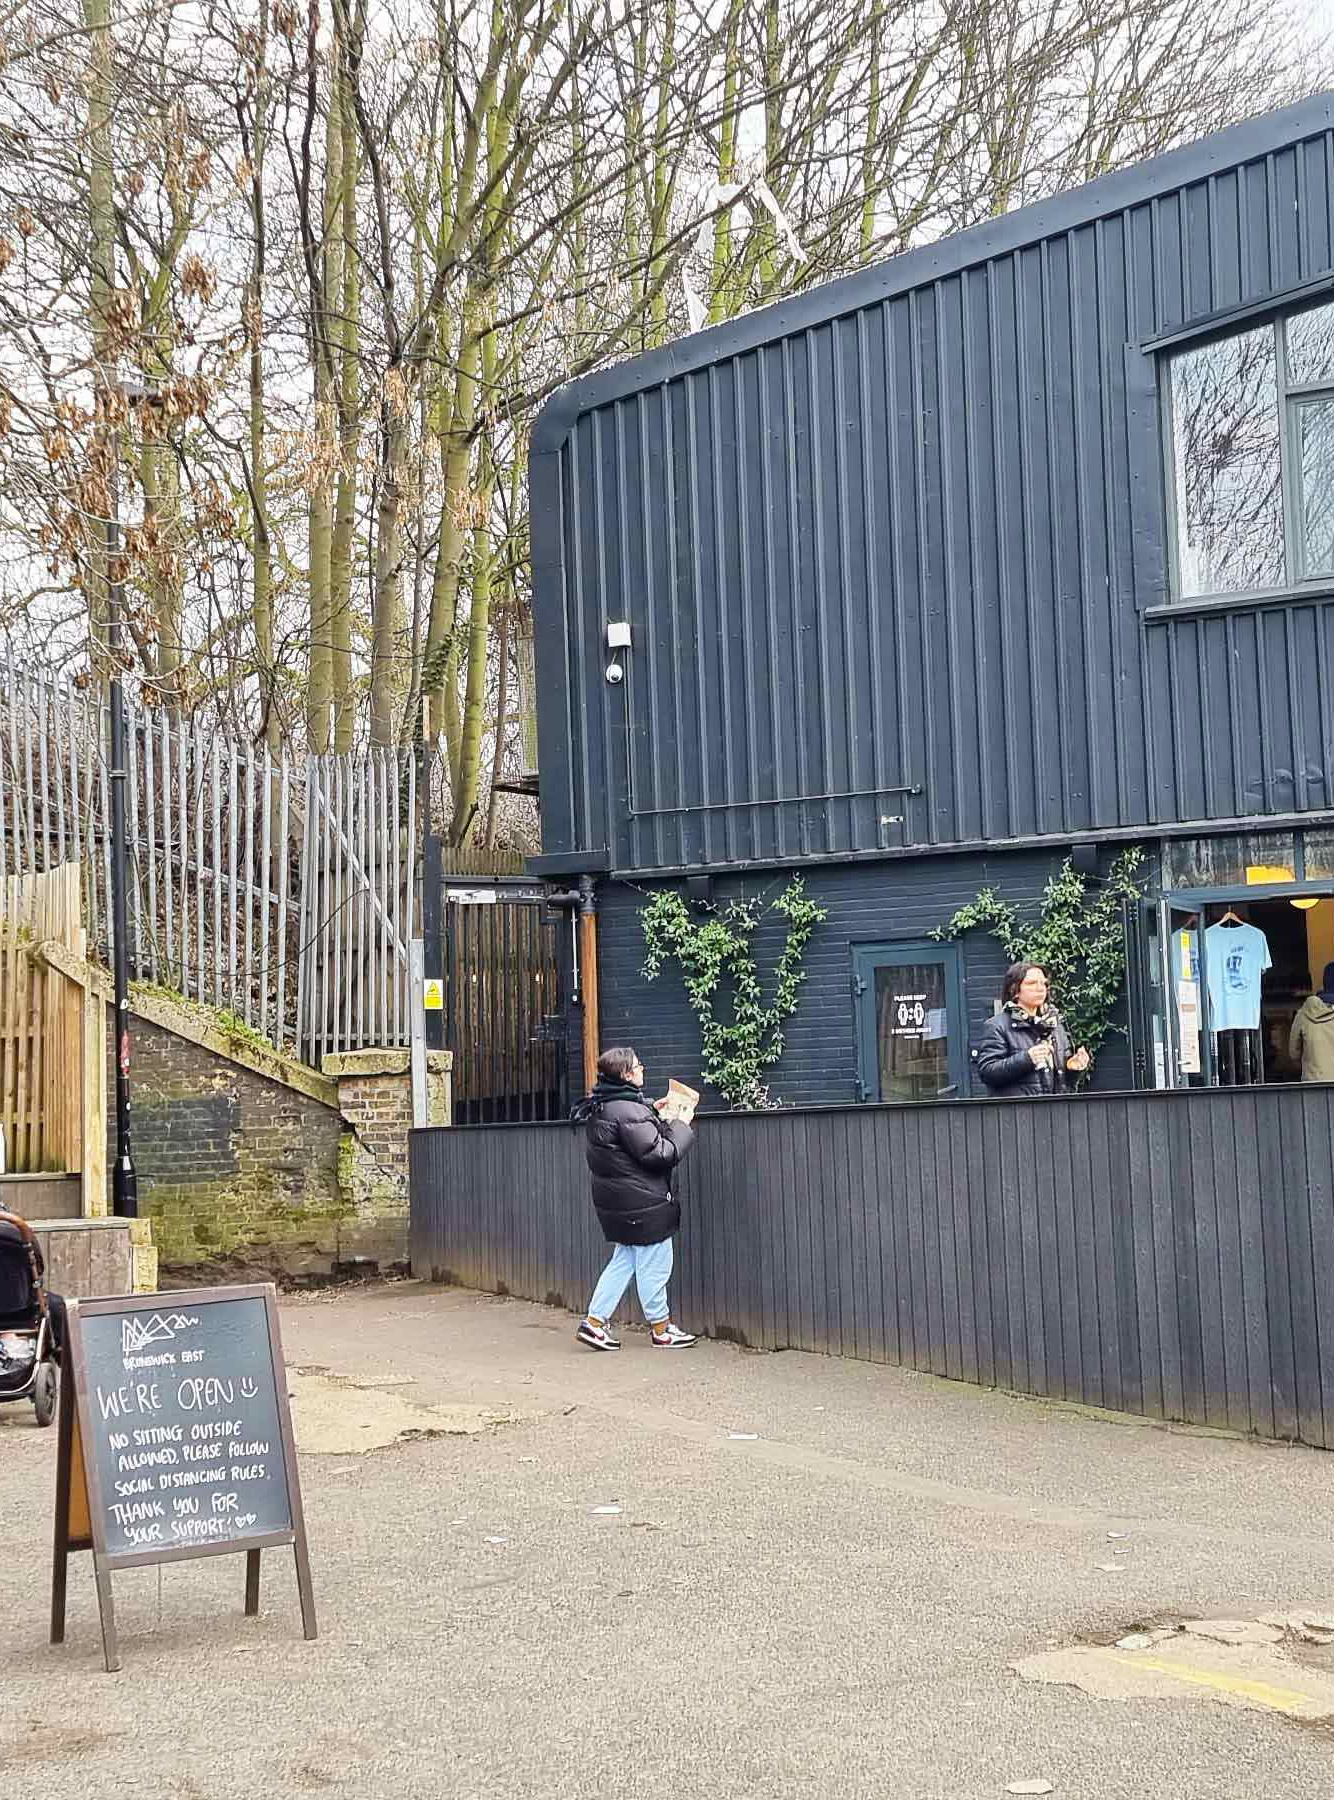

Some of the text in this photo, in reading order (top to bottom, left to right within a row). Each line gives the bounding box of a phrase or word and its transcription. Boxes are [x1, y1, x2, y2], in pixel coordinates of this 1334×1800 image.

[181, 1350, 205, 1363] EAST
[97, 1376, 234, 1419] WE'RE OPEN
[109, 1420, 243, 1450] NO SITTING OUTSIDE
[119, 1441, 269, 1472] ALLOWED, PLEASE FOLLOW
[115, 1480, 155, 1497] SOCIAL
[159, 1466, 226, 1490] DISTANCING
[108, 1492, 239, 1526] THANK YOU FOR
[123, 1523, 164, 1547] YOUR
